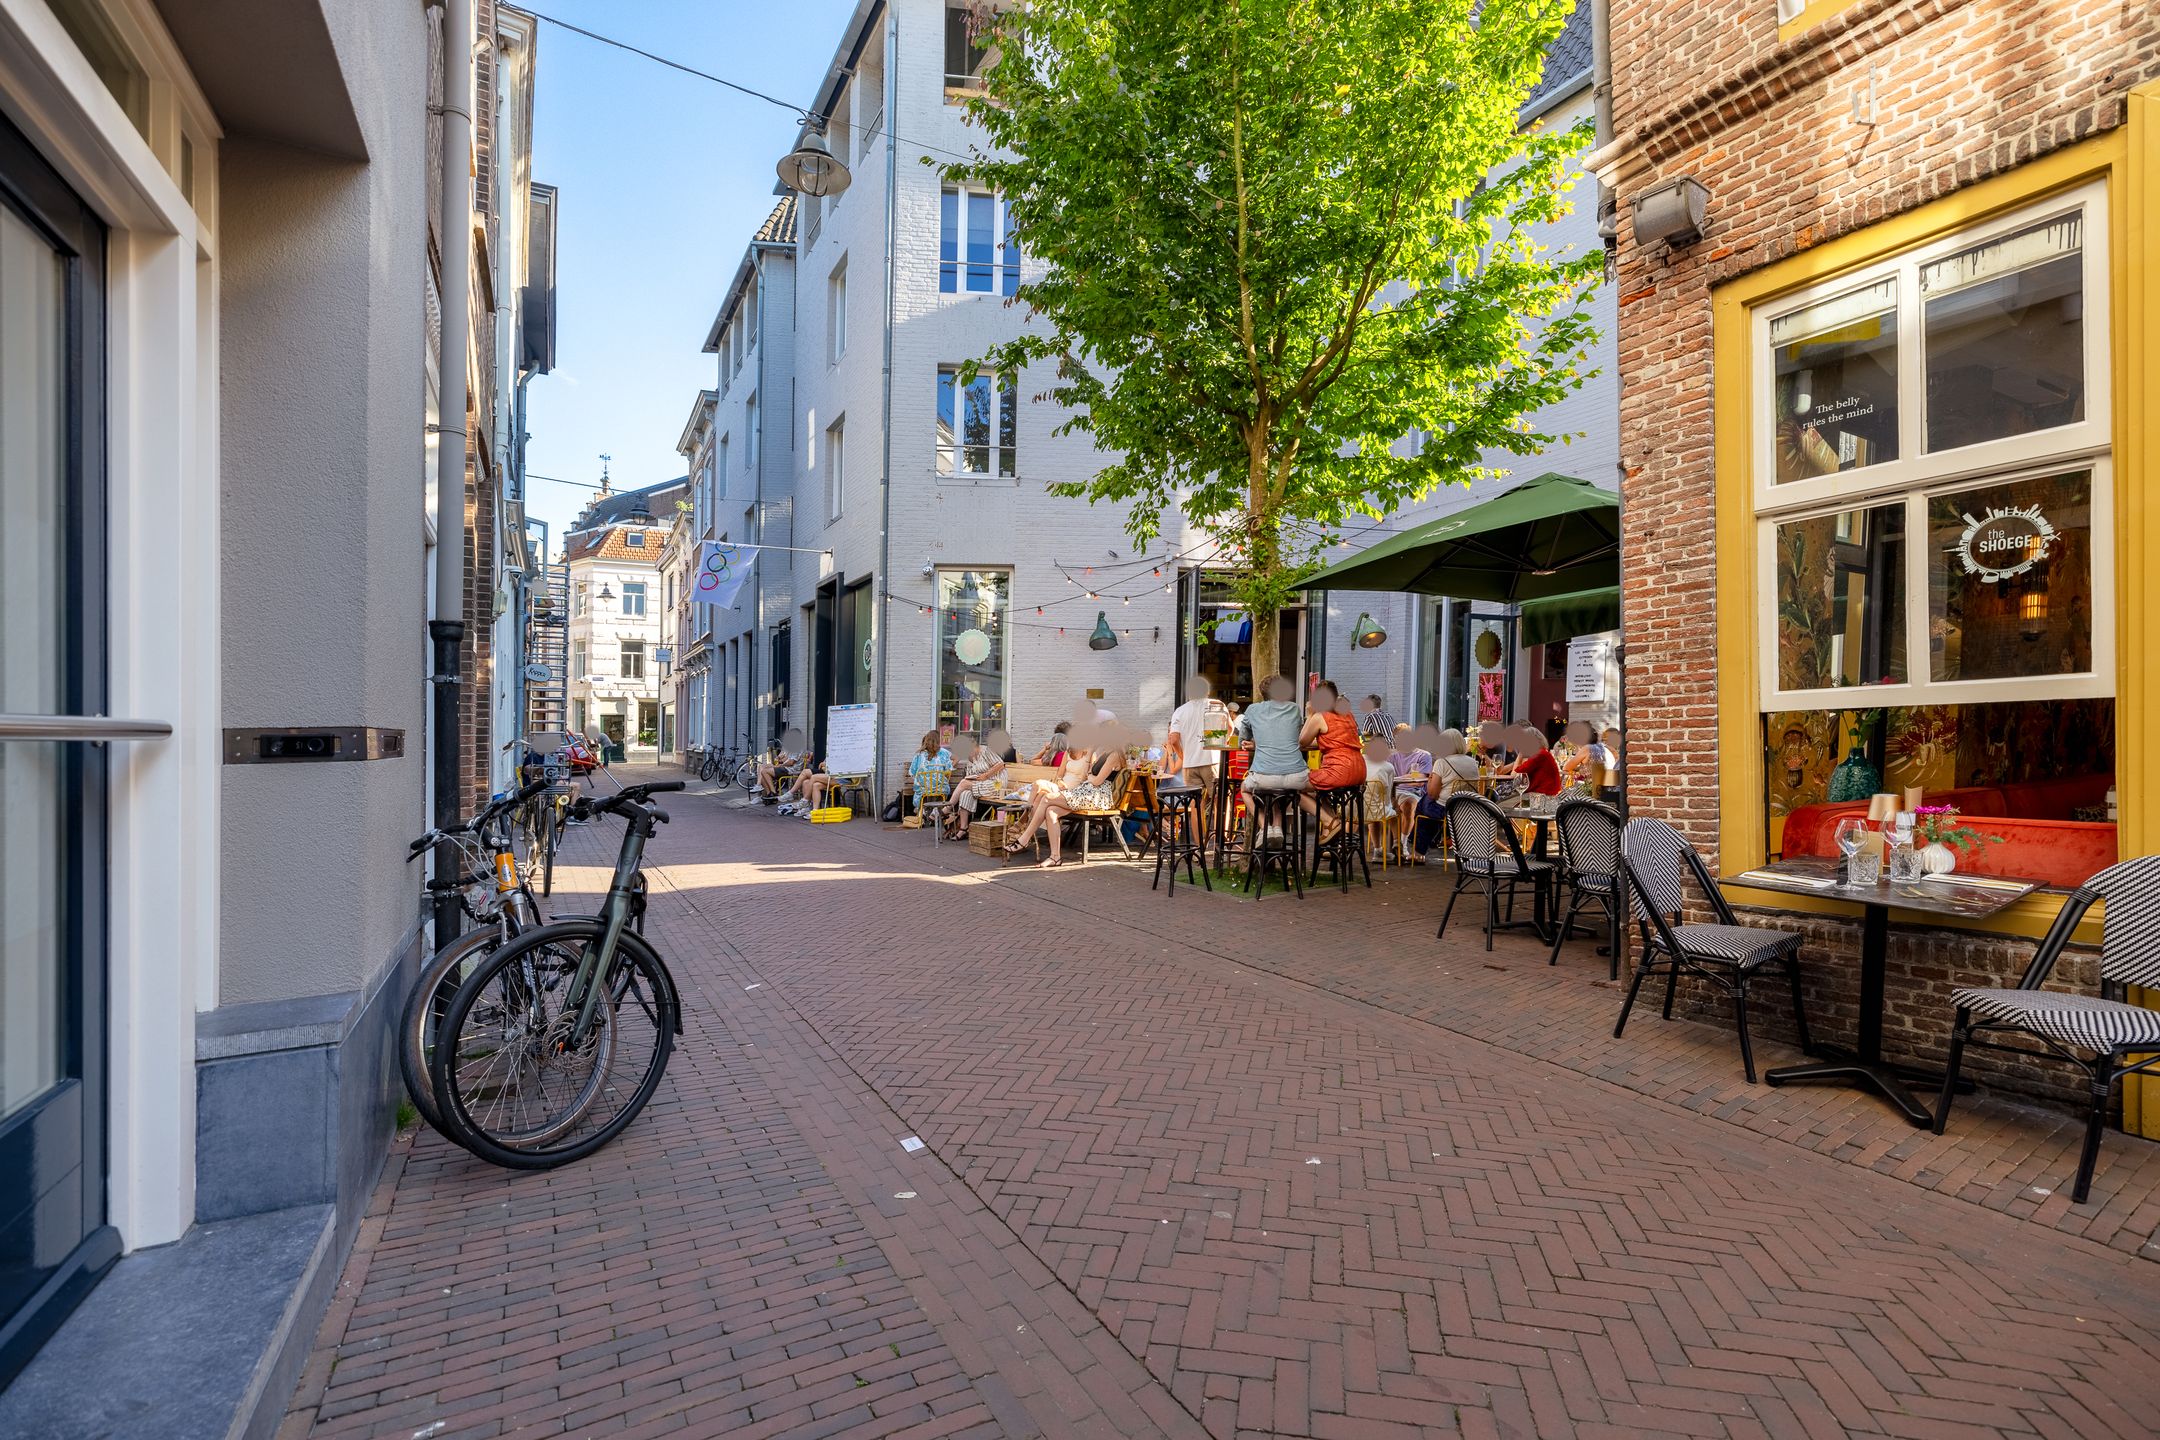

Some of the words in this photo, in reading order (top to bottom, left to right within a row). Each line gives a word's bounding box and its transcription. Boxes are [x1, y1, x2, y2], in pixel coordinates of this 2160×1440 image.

[1815, 404, 1834, 414] The
[1836, 396, 1860, 409] belly
[1802, 418, 1826, 429] rules
[1828, 413, 1844, 423] the
[1846, 404, 1873, 419] mind
[1979, 534, 2032, 553] SHOEGE
[1988, 529, 2005, 540] the
